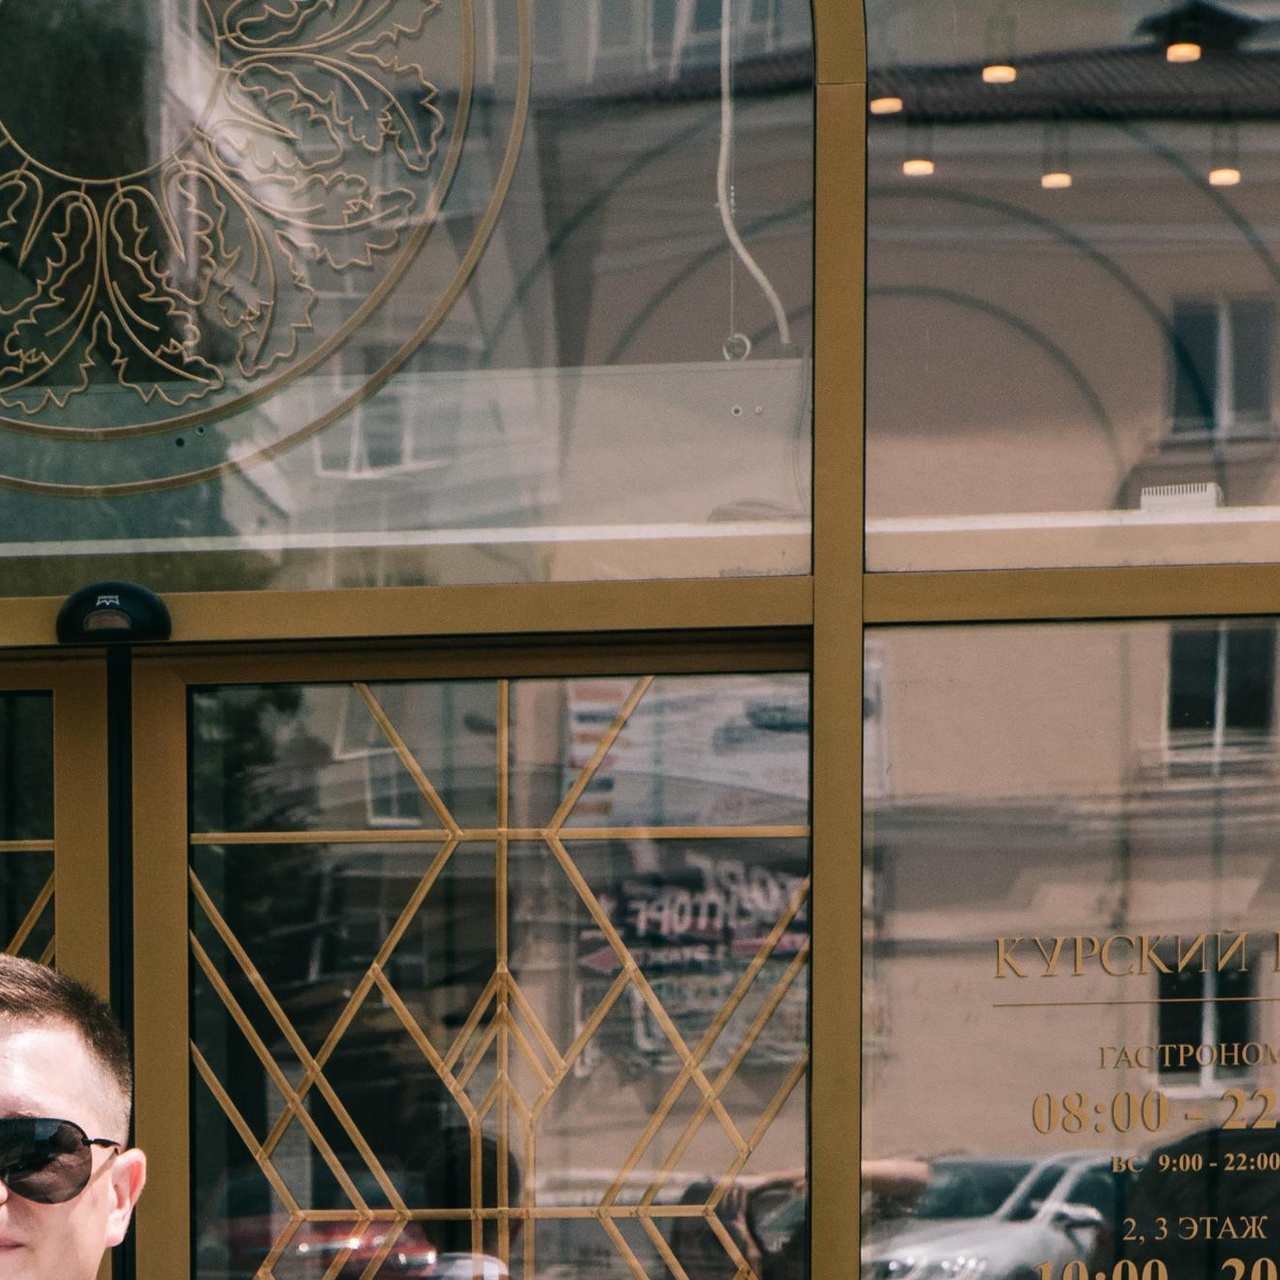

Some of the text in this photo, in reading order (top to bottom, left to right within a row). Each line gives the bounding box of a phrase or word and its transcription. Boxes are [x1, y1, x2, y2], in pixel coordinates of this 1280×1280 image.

[994, 930, 1248, 978] КУРСКИЙ
[1098, 1042, 1280, 1069] ГАСТРОНОМ
[1032, 1090, 1169, 1134] 08:00
[1111, 1155, 1144, 1173] ВС
[1158, 1154, 1203, 1173] 9:00
[1223, 1153, 1280, 1172] 22:00
[1122, 1215, 1268, 1244] 2, 3 ЭТАЖ
